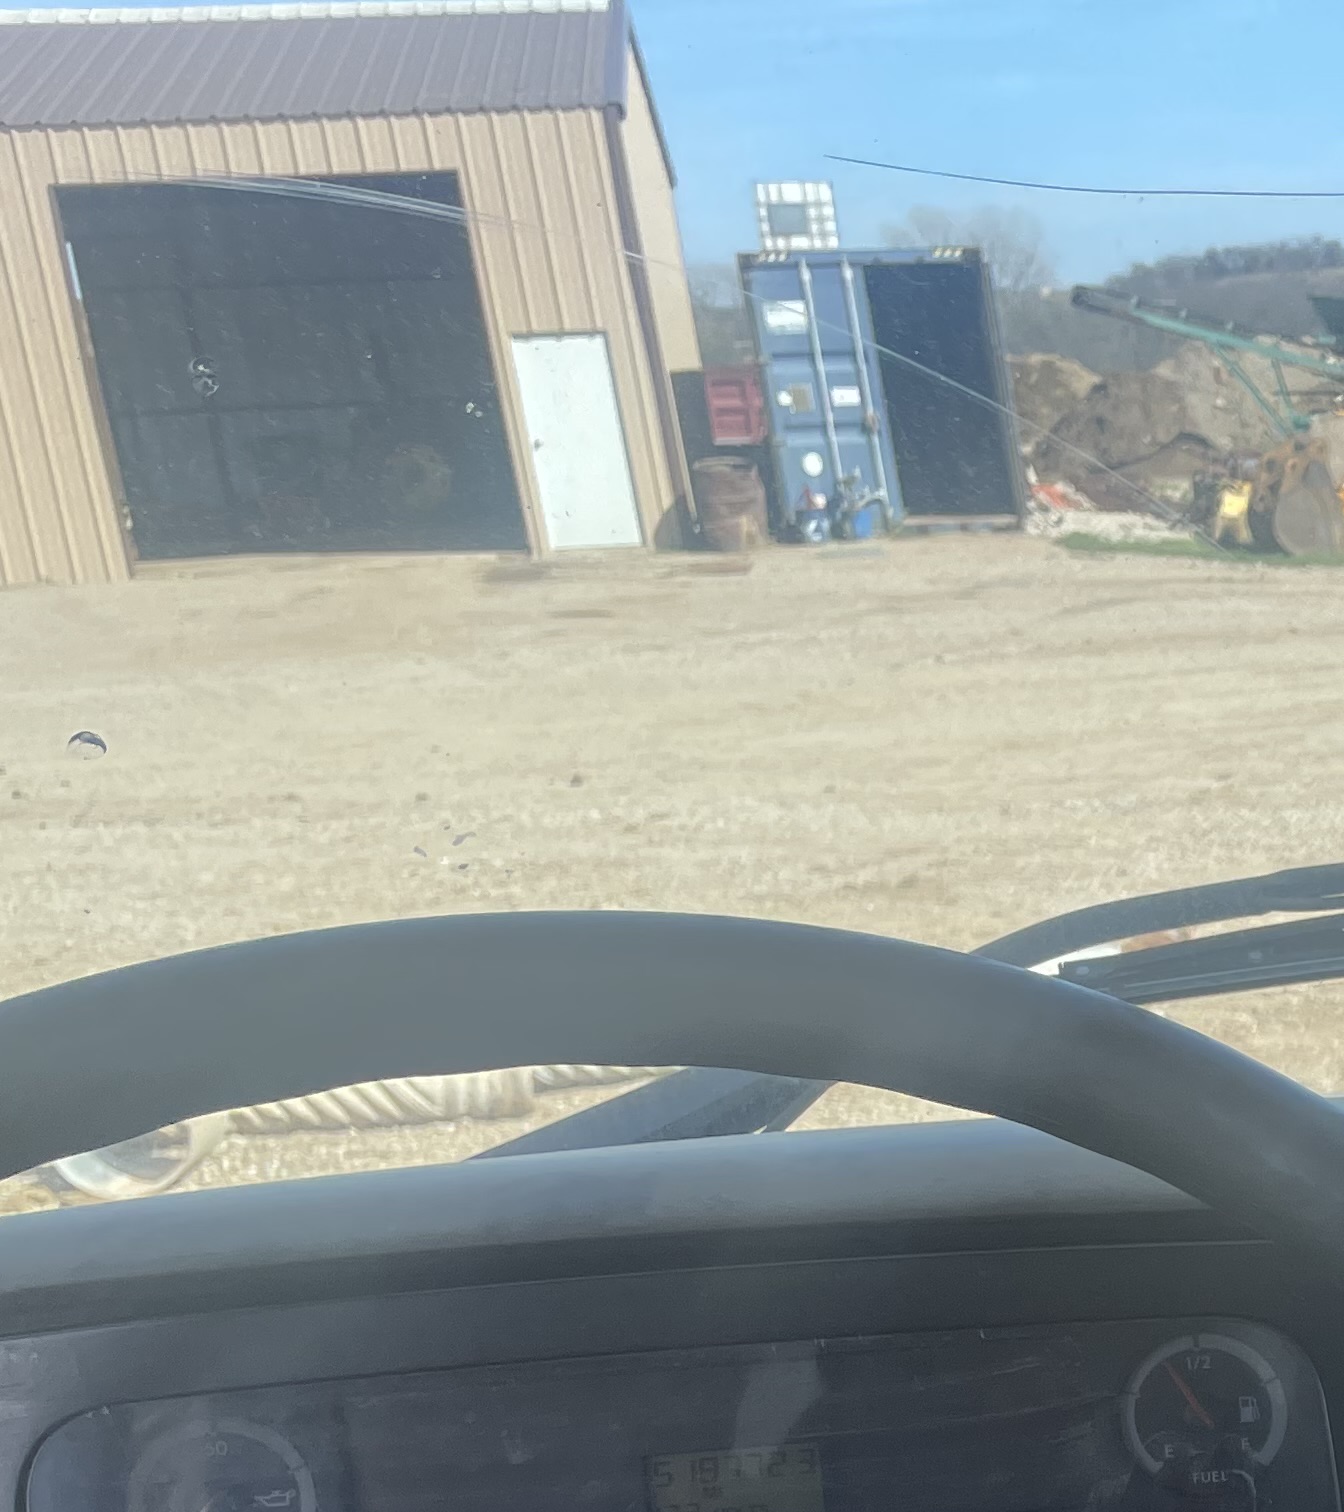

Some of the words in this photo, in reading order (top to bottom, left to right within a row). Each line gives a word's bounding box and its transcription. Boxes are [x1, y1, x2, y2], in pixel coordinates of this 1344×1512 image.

[1186, 1356, 1212, 1370] 1/2
[1241, 1437, 1250, 1451] F
[1164, 1445, 1175, 1458] E
[1192, 1472, 1228, 1485] FUEL
